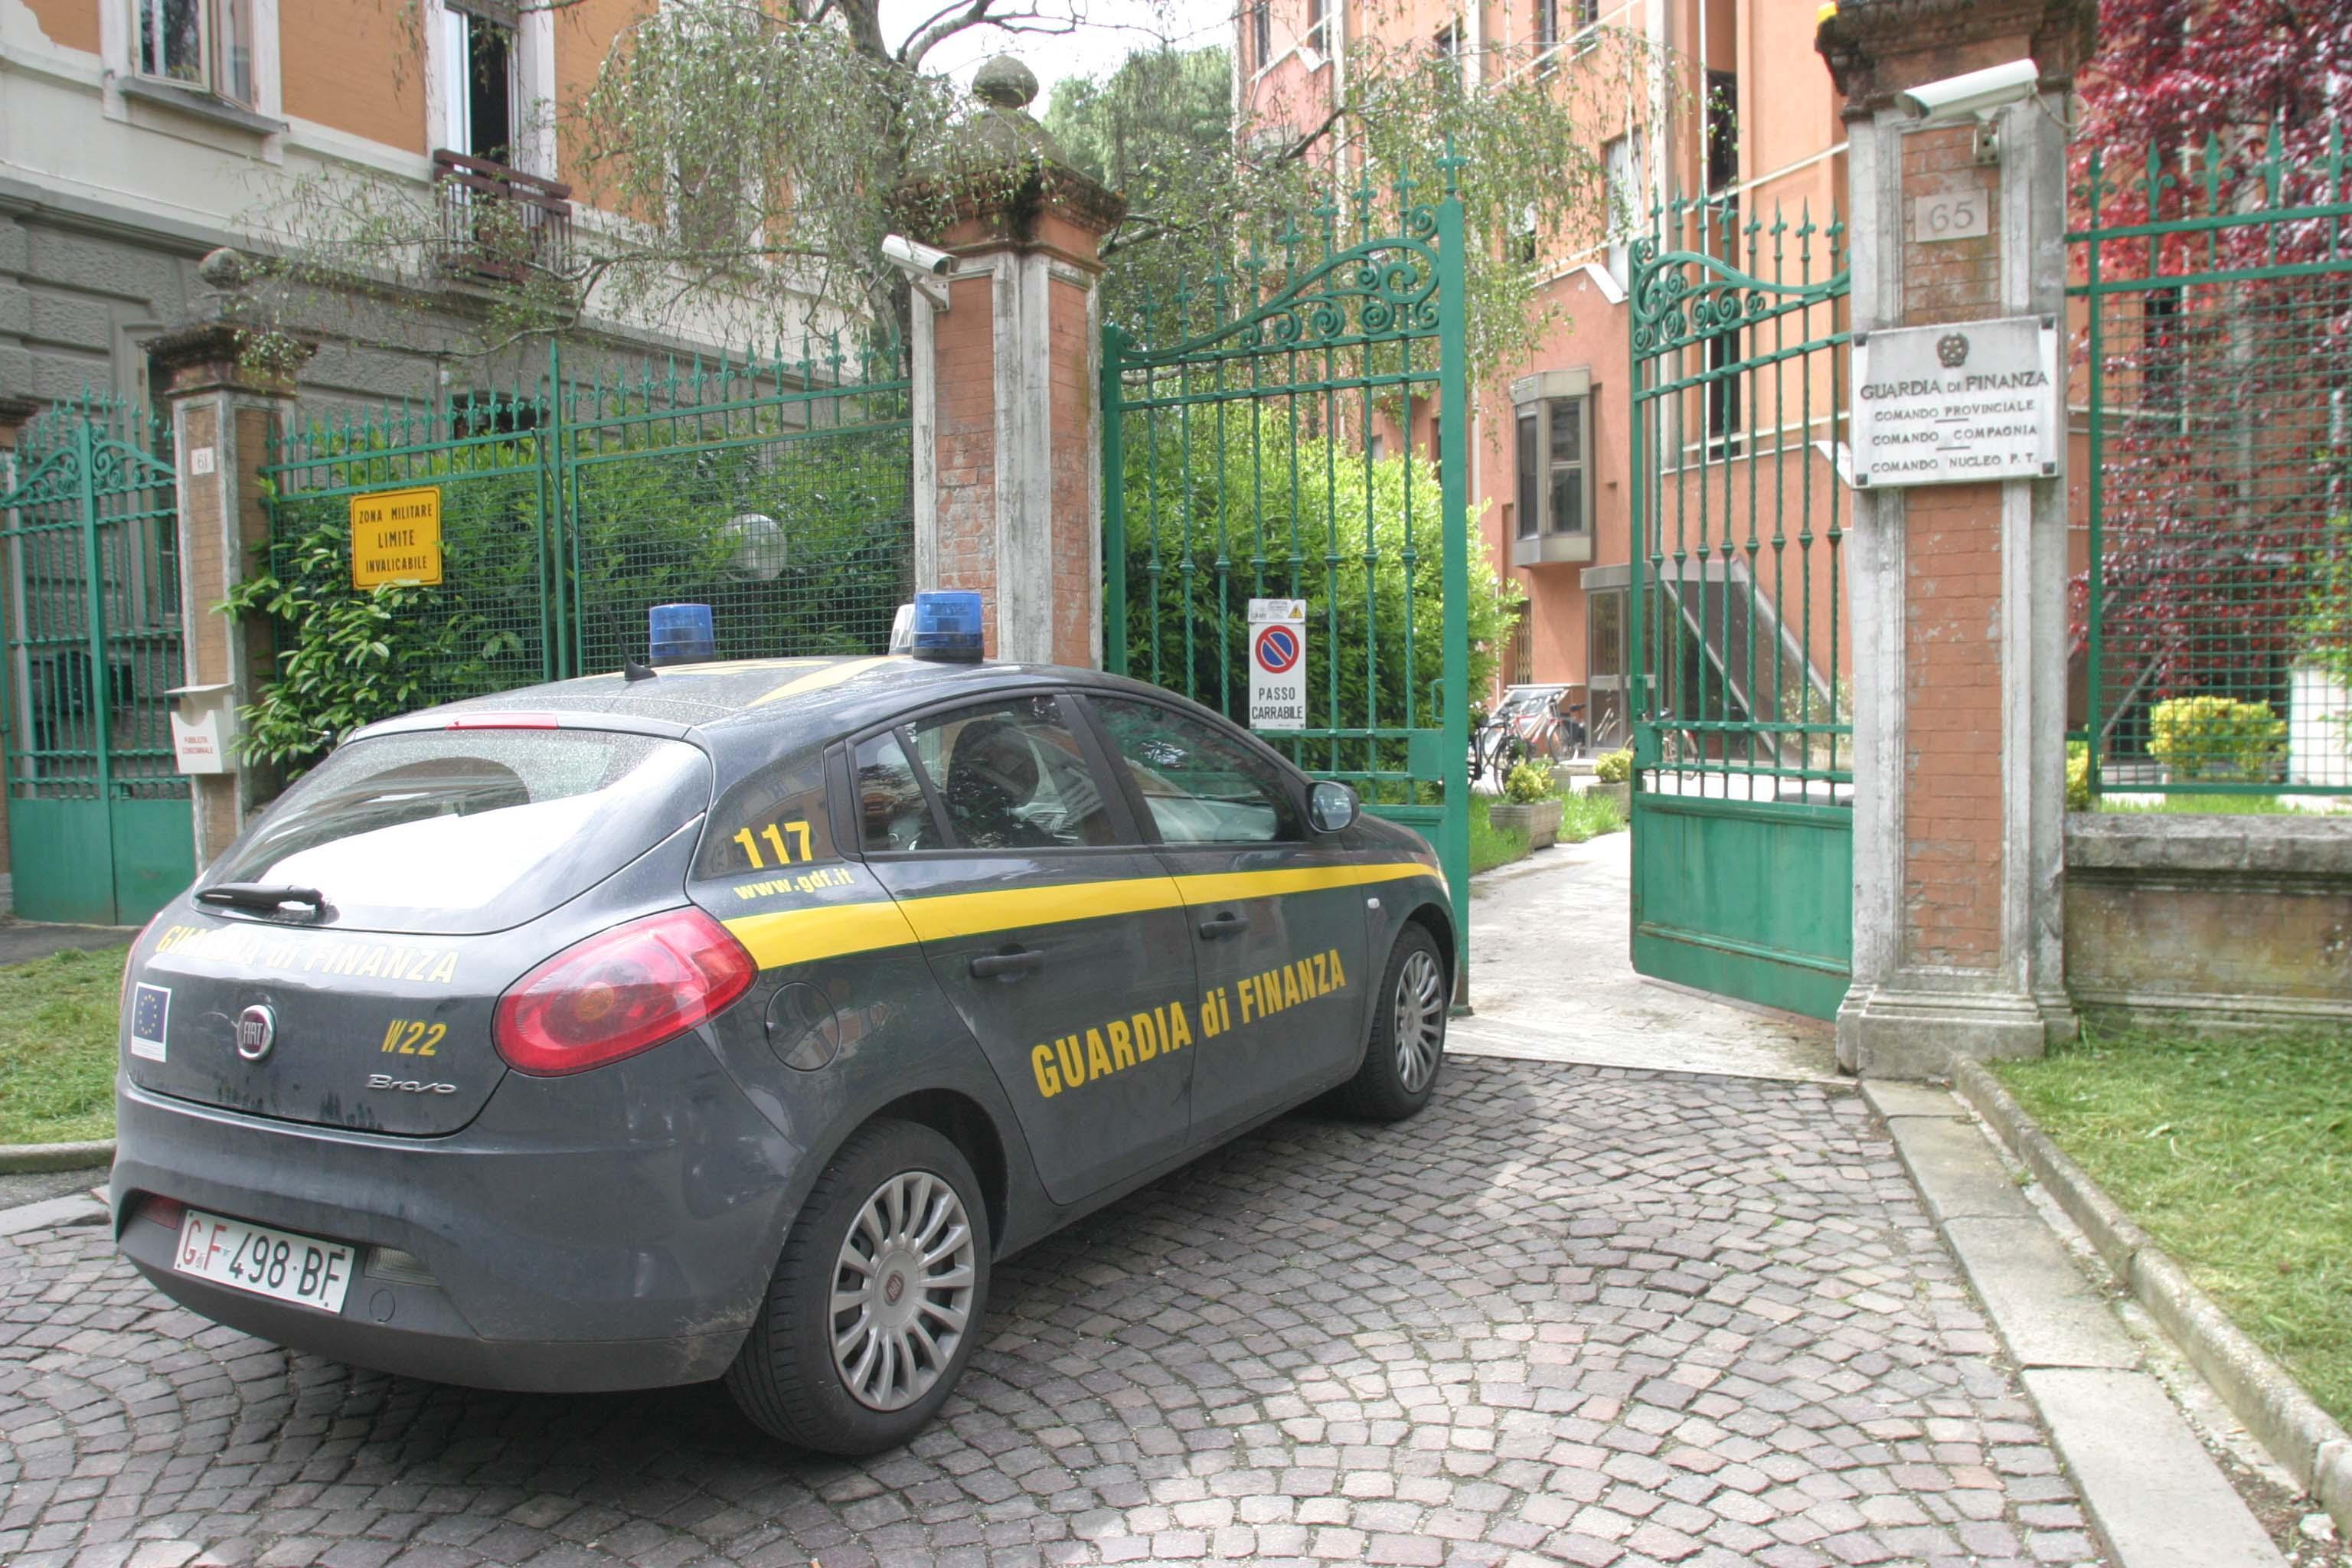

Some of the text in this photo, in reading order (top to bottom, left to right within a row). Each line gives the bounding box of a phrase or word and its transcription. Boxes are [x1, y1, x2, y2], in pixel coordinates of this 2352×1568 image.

[1929, 200, 1974, 232] 65
[1860, 379, 1942, 400] GUARDIA
[1965, 371, 2049, 392] FINANZA
[1875, 399, 2034, 422] COMANDO PROVINCIALE
[1872, 424, 2038, 446] COMANDO COMPAGNIA
[1871, 459, 1939, 473] COMANDO
[1949, 454, 2002, 468] NUCLEO
[358, 503, 433, 524] ZONA MILITARE
[377, 529, 415, 549] LIMITE
[365, 556, 428, 573] INVALICABILE
[1259, 687, 1296, 701] PASSO
[1251, 705, 1304, 720] CARRABILE
[733, 821, 813, 869] 117
[733, 867, 856, 900] www.gdf.it
[155, 925, 262, 966] GUAIA
[304, 942, 460, 984] FINANZA
[243, 1021, 264, 1046] FIAT
[1031, 949, 1348, 1099] GUARDIA di FINANZA
[381, 1019, 447, 1057] W22
[366, 1073, 457, 1094] Bravo
